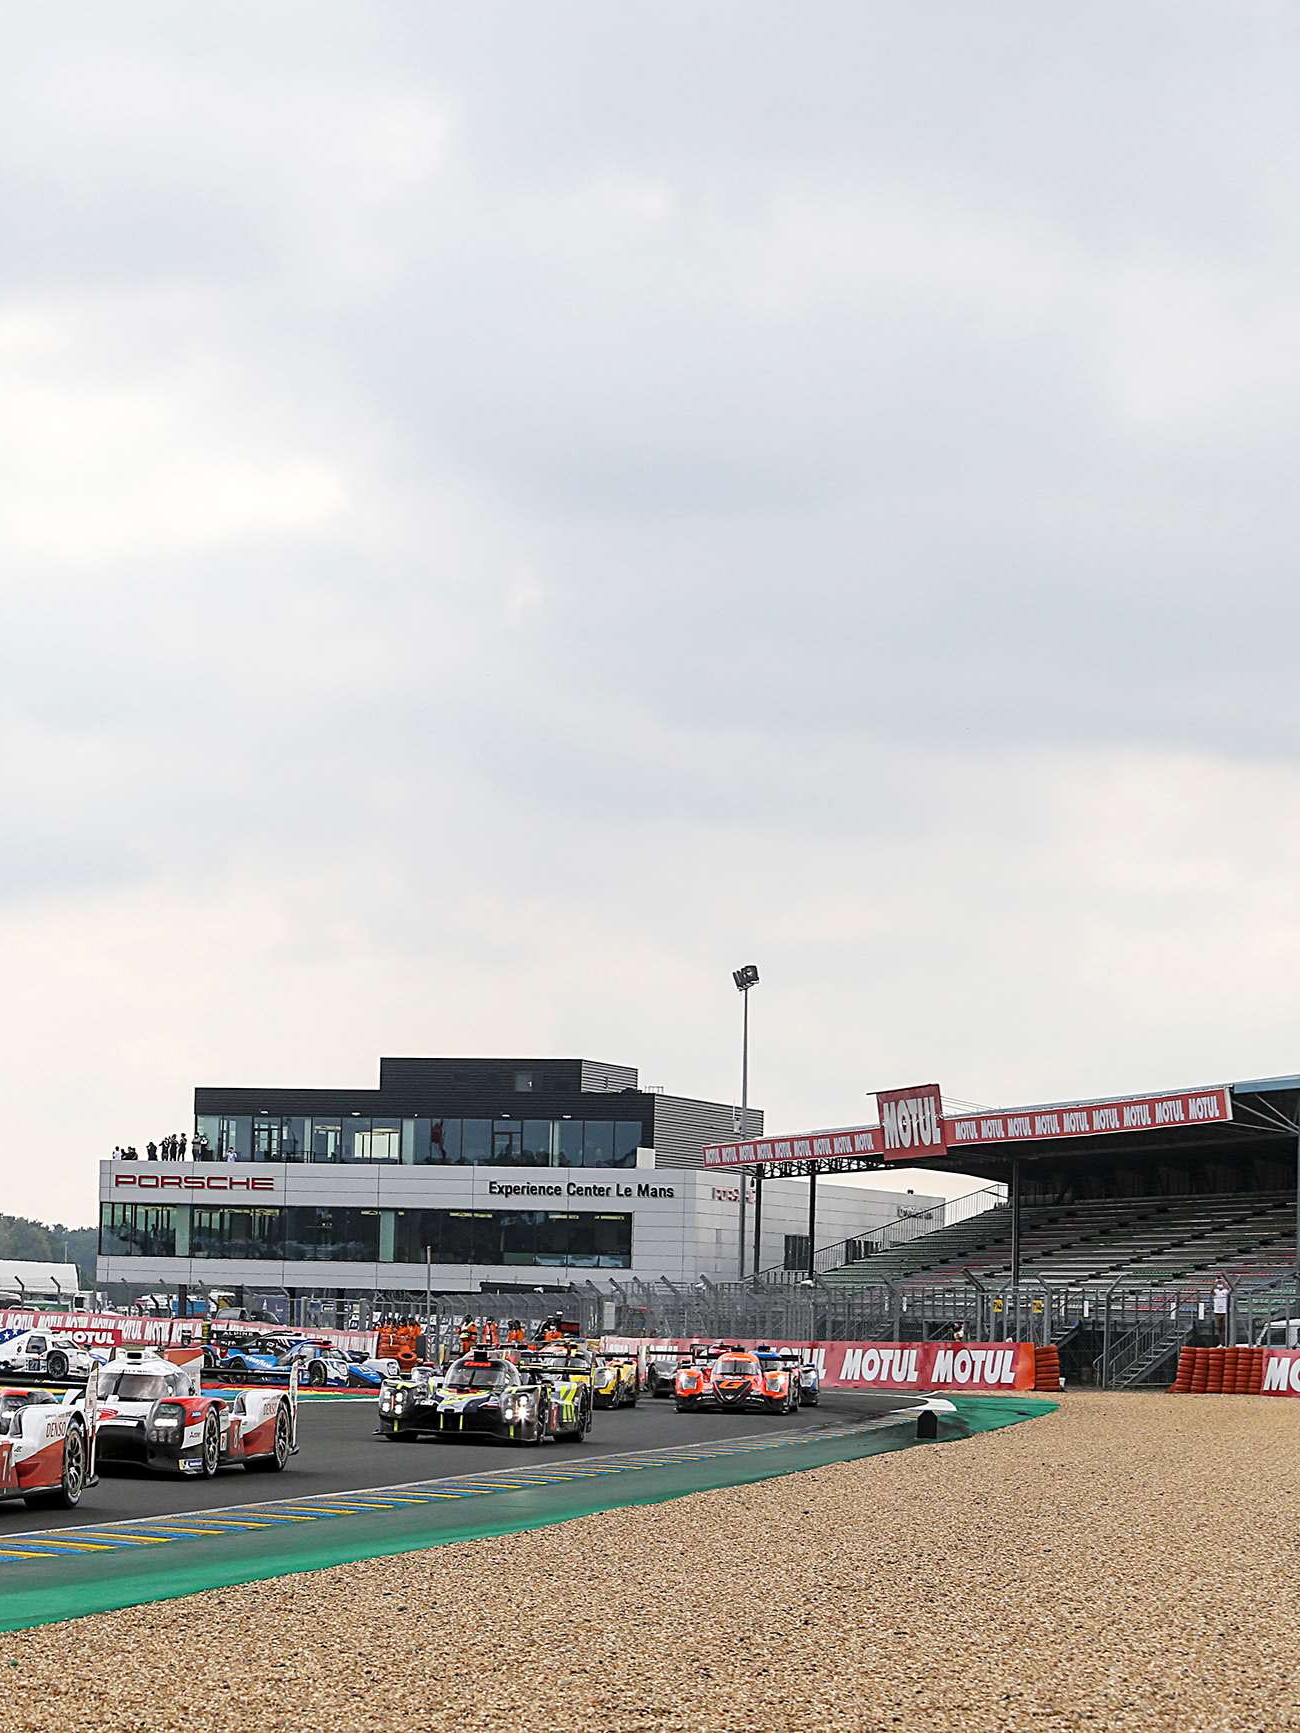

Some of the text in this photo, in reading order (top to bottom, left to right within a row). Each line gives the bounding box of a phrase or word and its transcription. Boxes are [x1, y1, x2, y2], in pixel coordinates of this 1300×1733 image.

[883, 1096, 942, 1149] MOTUL
[955, 1096, 1220, 1140] MOTUL MOTUL MOTUL MOTUL MOTUL MOTUL MOTUL MOTUL MOTUL
[854, 1133, 874, 1152] MOTUL
[115, 1174, 274, 1191] PORSCHE
[489, 1181, 674, 1198] Experience Center Le Mans
[7, 1313, 35, 1329] MOTUL
[117, 1320, 142, 1341] MOTUL
[839, 1348, 1017, 1385] MOTUL MOTUL
[45, 1421, 67, 1440] DENSO
[2, 1451, 10, 1481] 7
